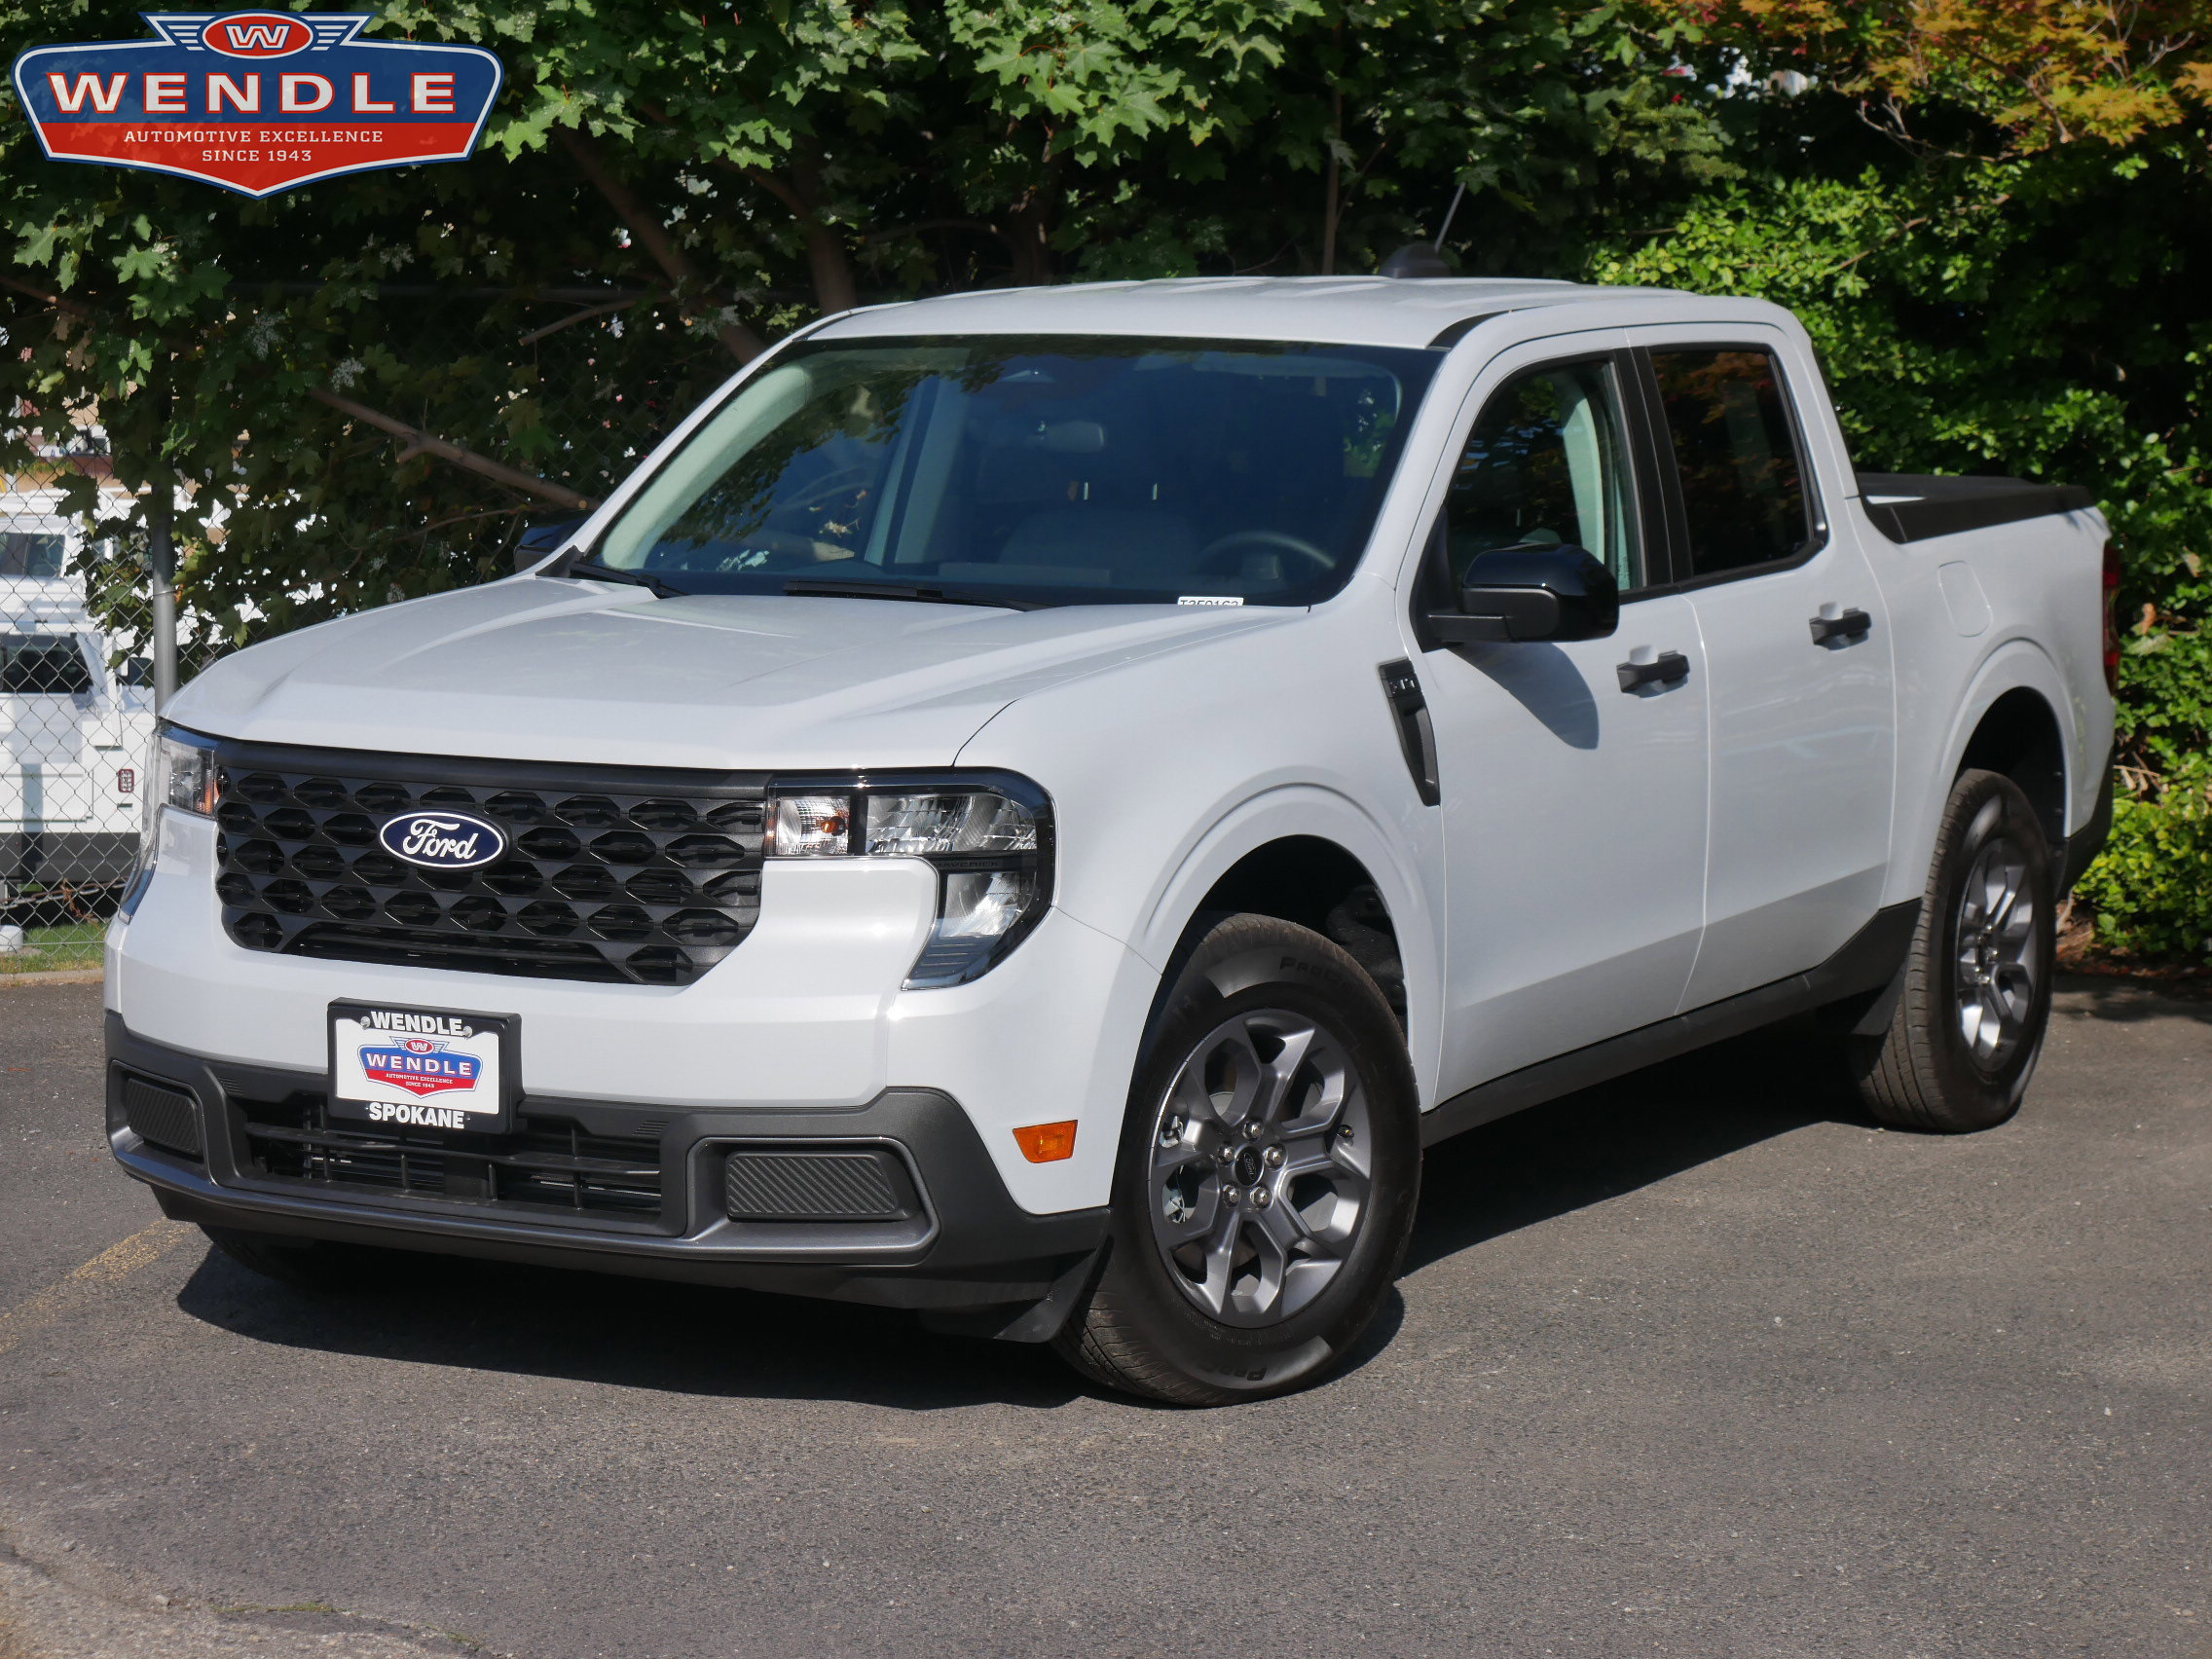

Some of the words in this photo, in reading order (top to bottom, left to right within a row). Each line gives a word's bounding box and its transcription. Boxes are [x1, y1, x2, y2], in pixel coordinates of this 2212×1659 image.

[402, 819, 479, 860] Ford
[371, 1011, 462, 1036] WENDLE
[366, 1052, 472, 1076] WENDLE
[420, 1076, 454, 1085] EXCELLENCE
[369, 1102, 464, 1129] SPOKANE
